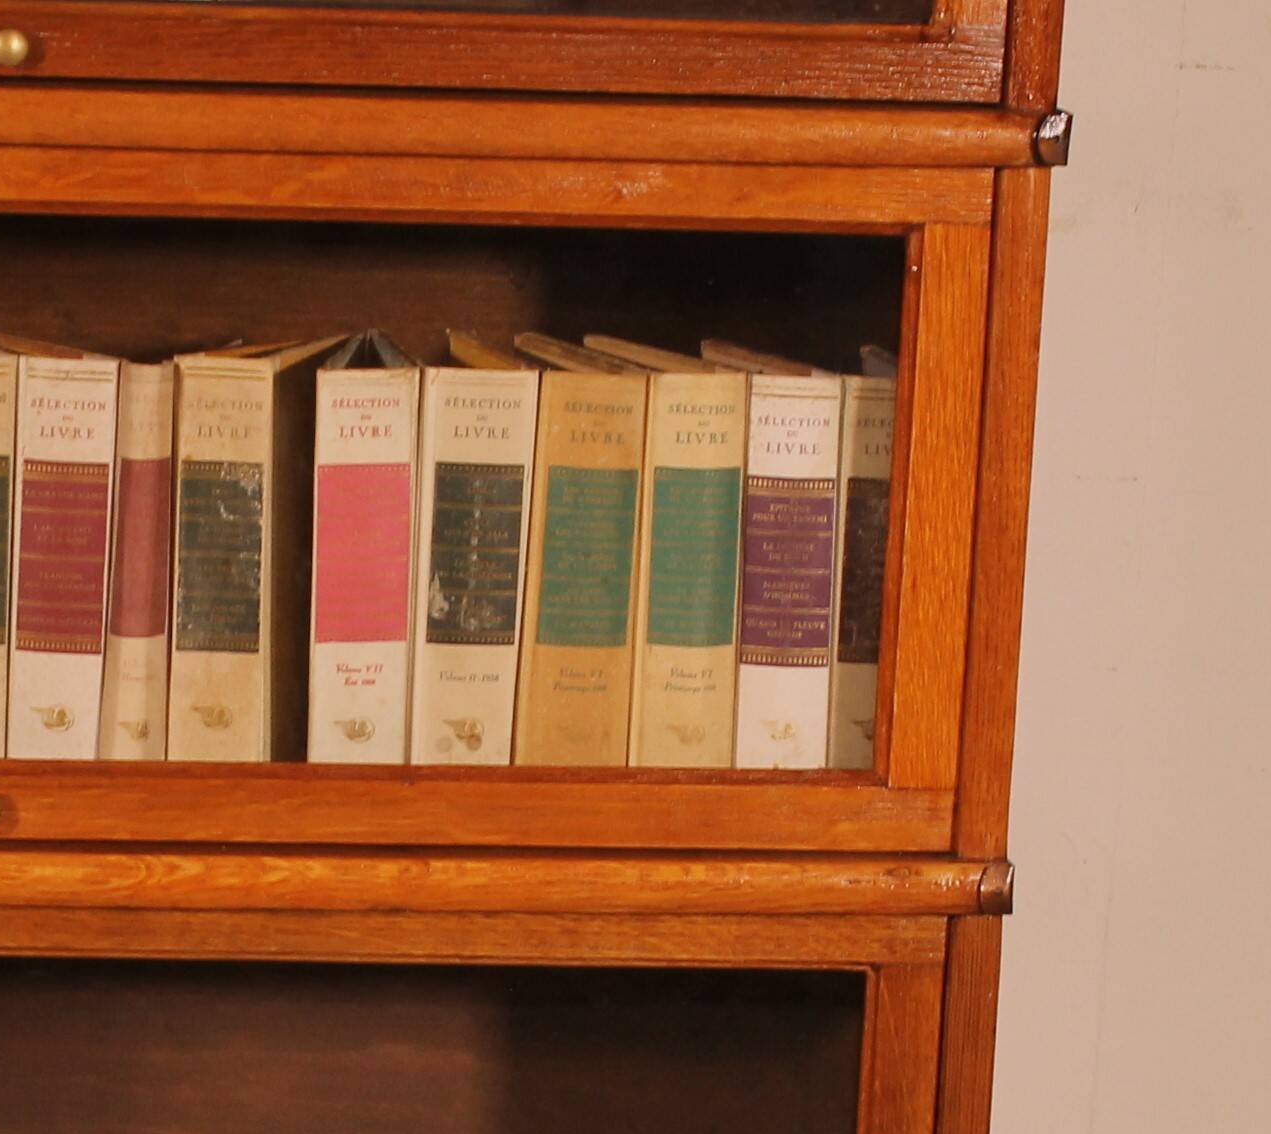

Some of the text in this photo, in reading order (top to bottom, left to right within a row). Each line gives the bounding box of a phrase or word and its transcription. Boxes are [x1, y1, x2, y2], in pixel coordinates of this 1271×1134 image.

[40, 426, 95, 439] LIVRE
[339, 425, 392, 438] LIVRE
[454, 425, 510, 439] LIVRE
[570, 431, 625, 444] LIVRE
[676, 431, 729, 444] LIVRE
[766, 442, 822, 454] LIVRE
